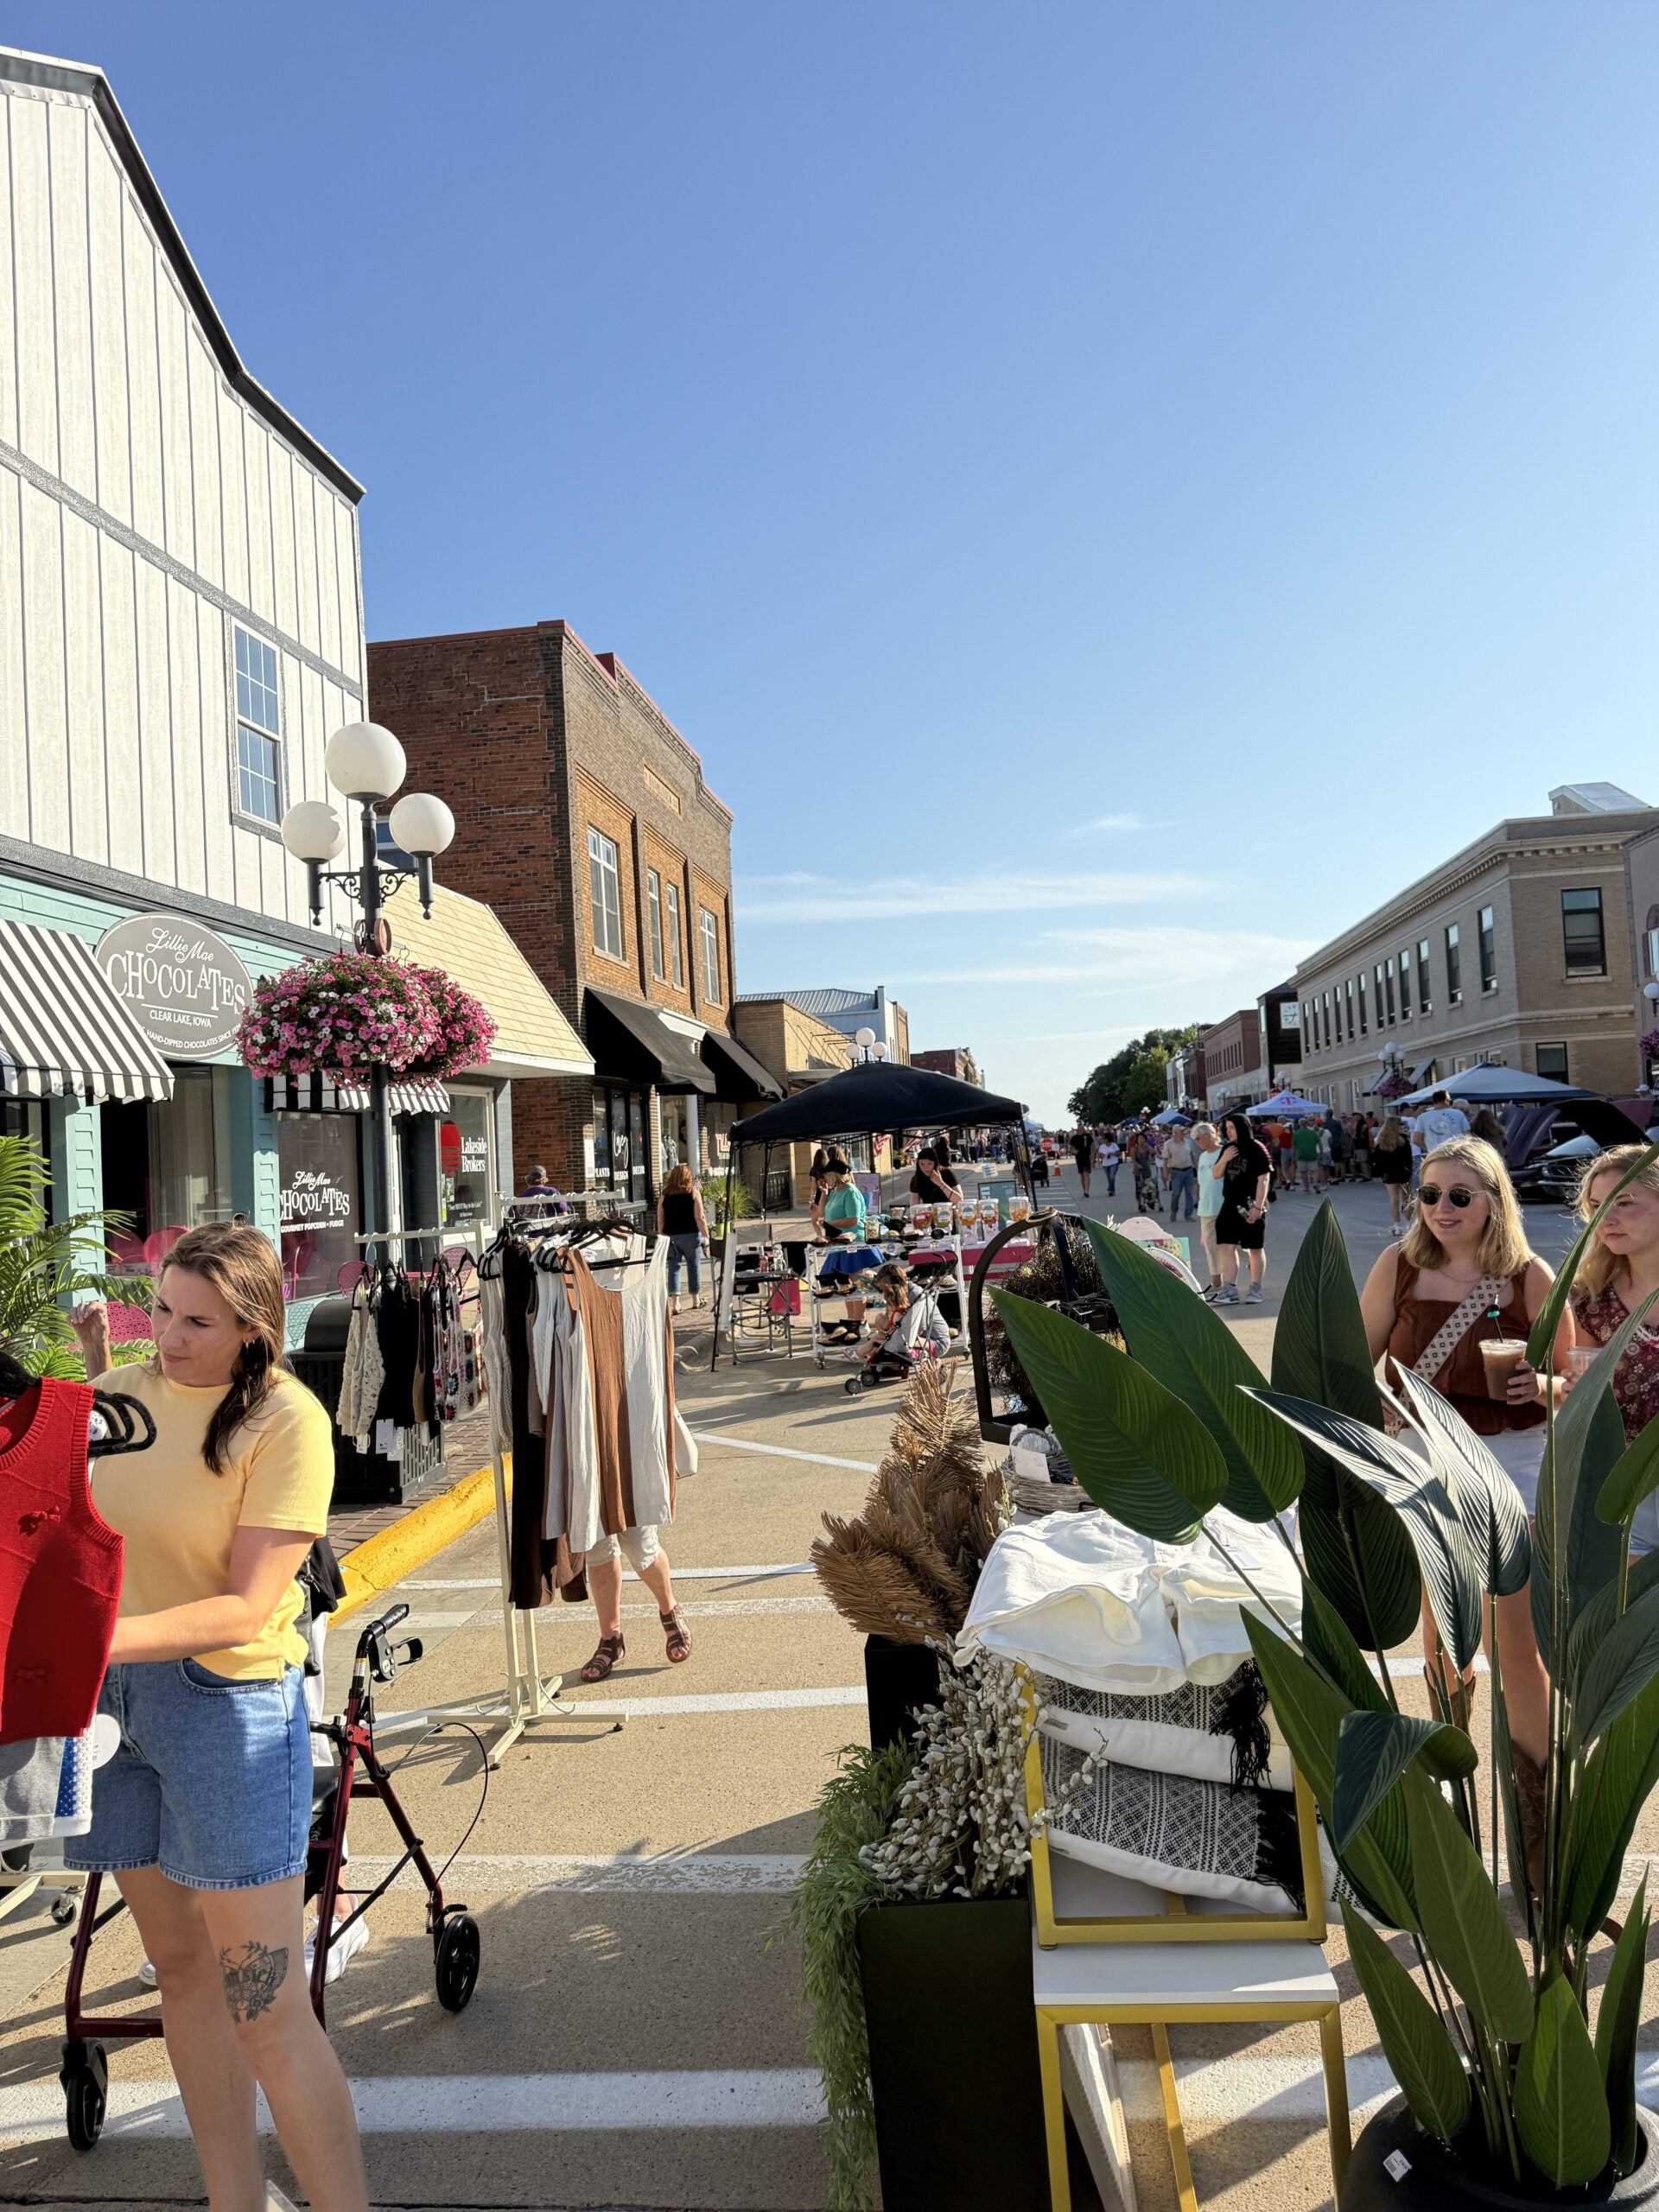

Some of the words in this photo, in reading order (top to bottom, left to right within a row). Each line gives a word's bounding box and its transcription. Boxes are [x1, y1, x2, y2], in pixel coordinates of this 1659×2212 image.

[145, 927, 188, 953] Lillie
[175, 940, 214, 963] Mae
[106, 950, 245, 1015] CHOCOLATES
[149, 1009, 172, 1022] CLEAR
[173, 1012, 192, 1027] LAKE,
[193, 1016, 212, 1028] IOWA
[146, 1029, 183, 1048] HAND-DIPPED
[183, 1037, 218, 1049] CHOCOLATES
[218, 1030, 232, 1043] SINCE
[461, 1136, 487, 1154] Lakeside
[461, 1155, 486, 1173] Brokers
[292, 1170, 316, 1190] Lillie
[308, 1172, 331, 1191] Mae
[613, 1170, 629, 1181] DESIGN
[280, 1223, 304, 1233] GOURMET
[304, 1221, 327, 1230] POPCORN
[329, 1219, 345, 1228] FUDGE
